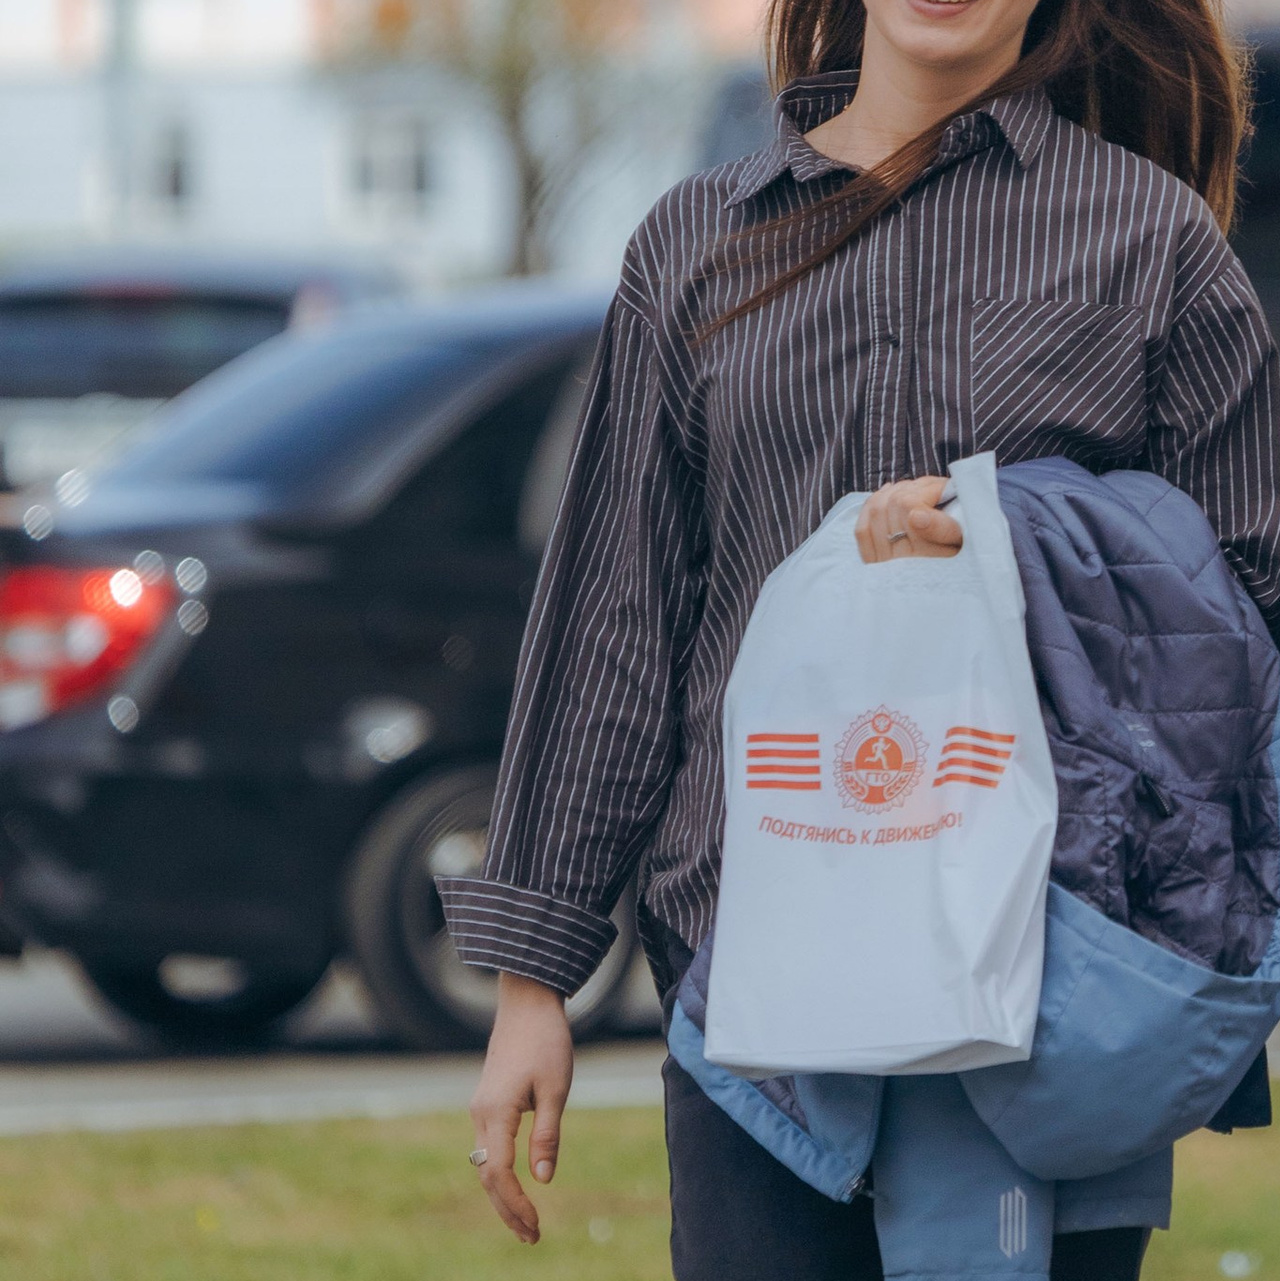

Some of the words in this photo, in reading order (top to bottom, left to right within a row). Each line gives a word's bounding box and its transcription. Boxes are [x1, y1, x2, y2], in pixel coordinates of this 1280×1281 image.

[865, 772, 890, 784] ГТО
[759, 816, 857, 844] ПОДТЯНИСЬ
[861, 829, 871, 844] К
